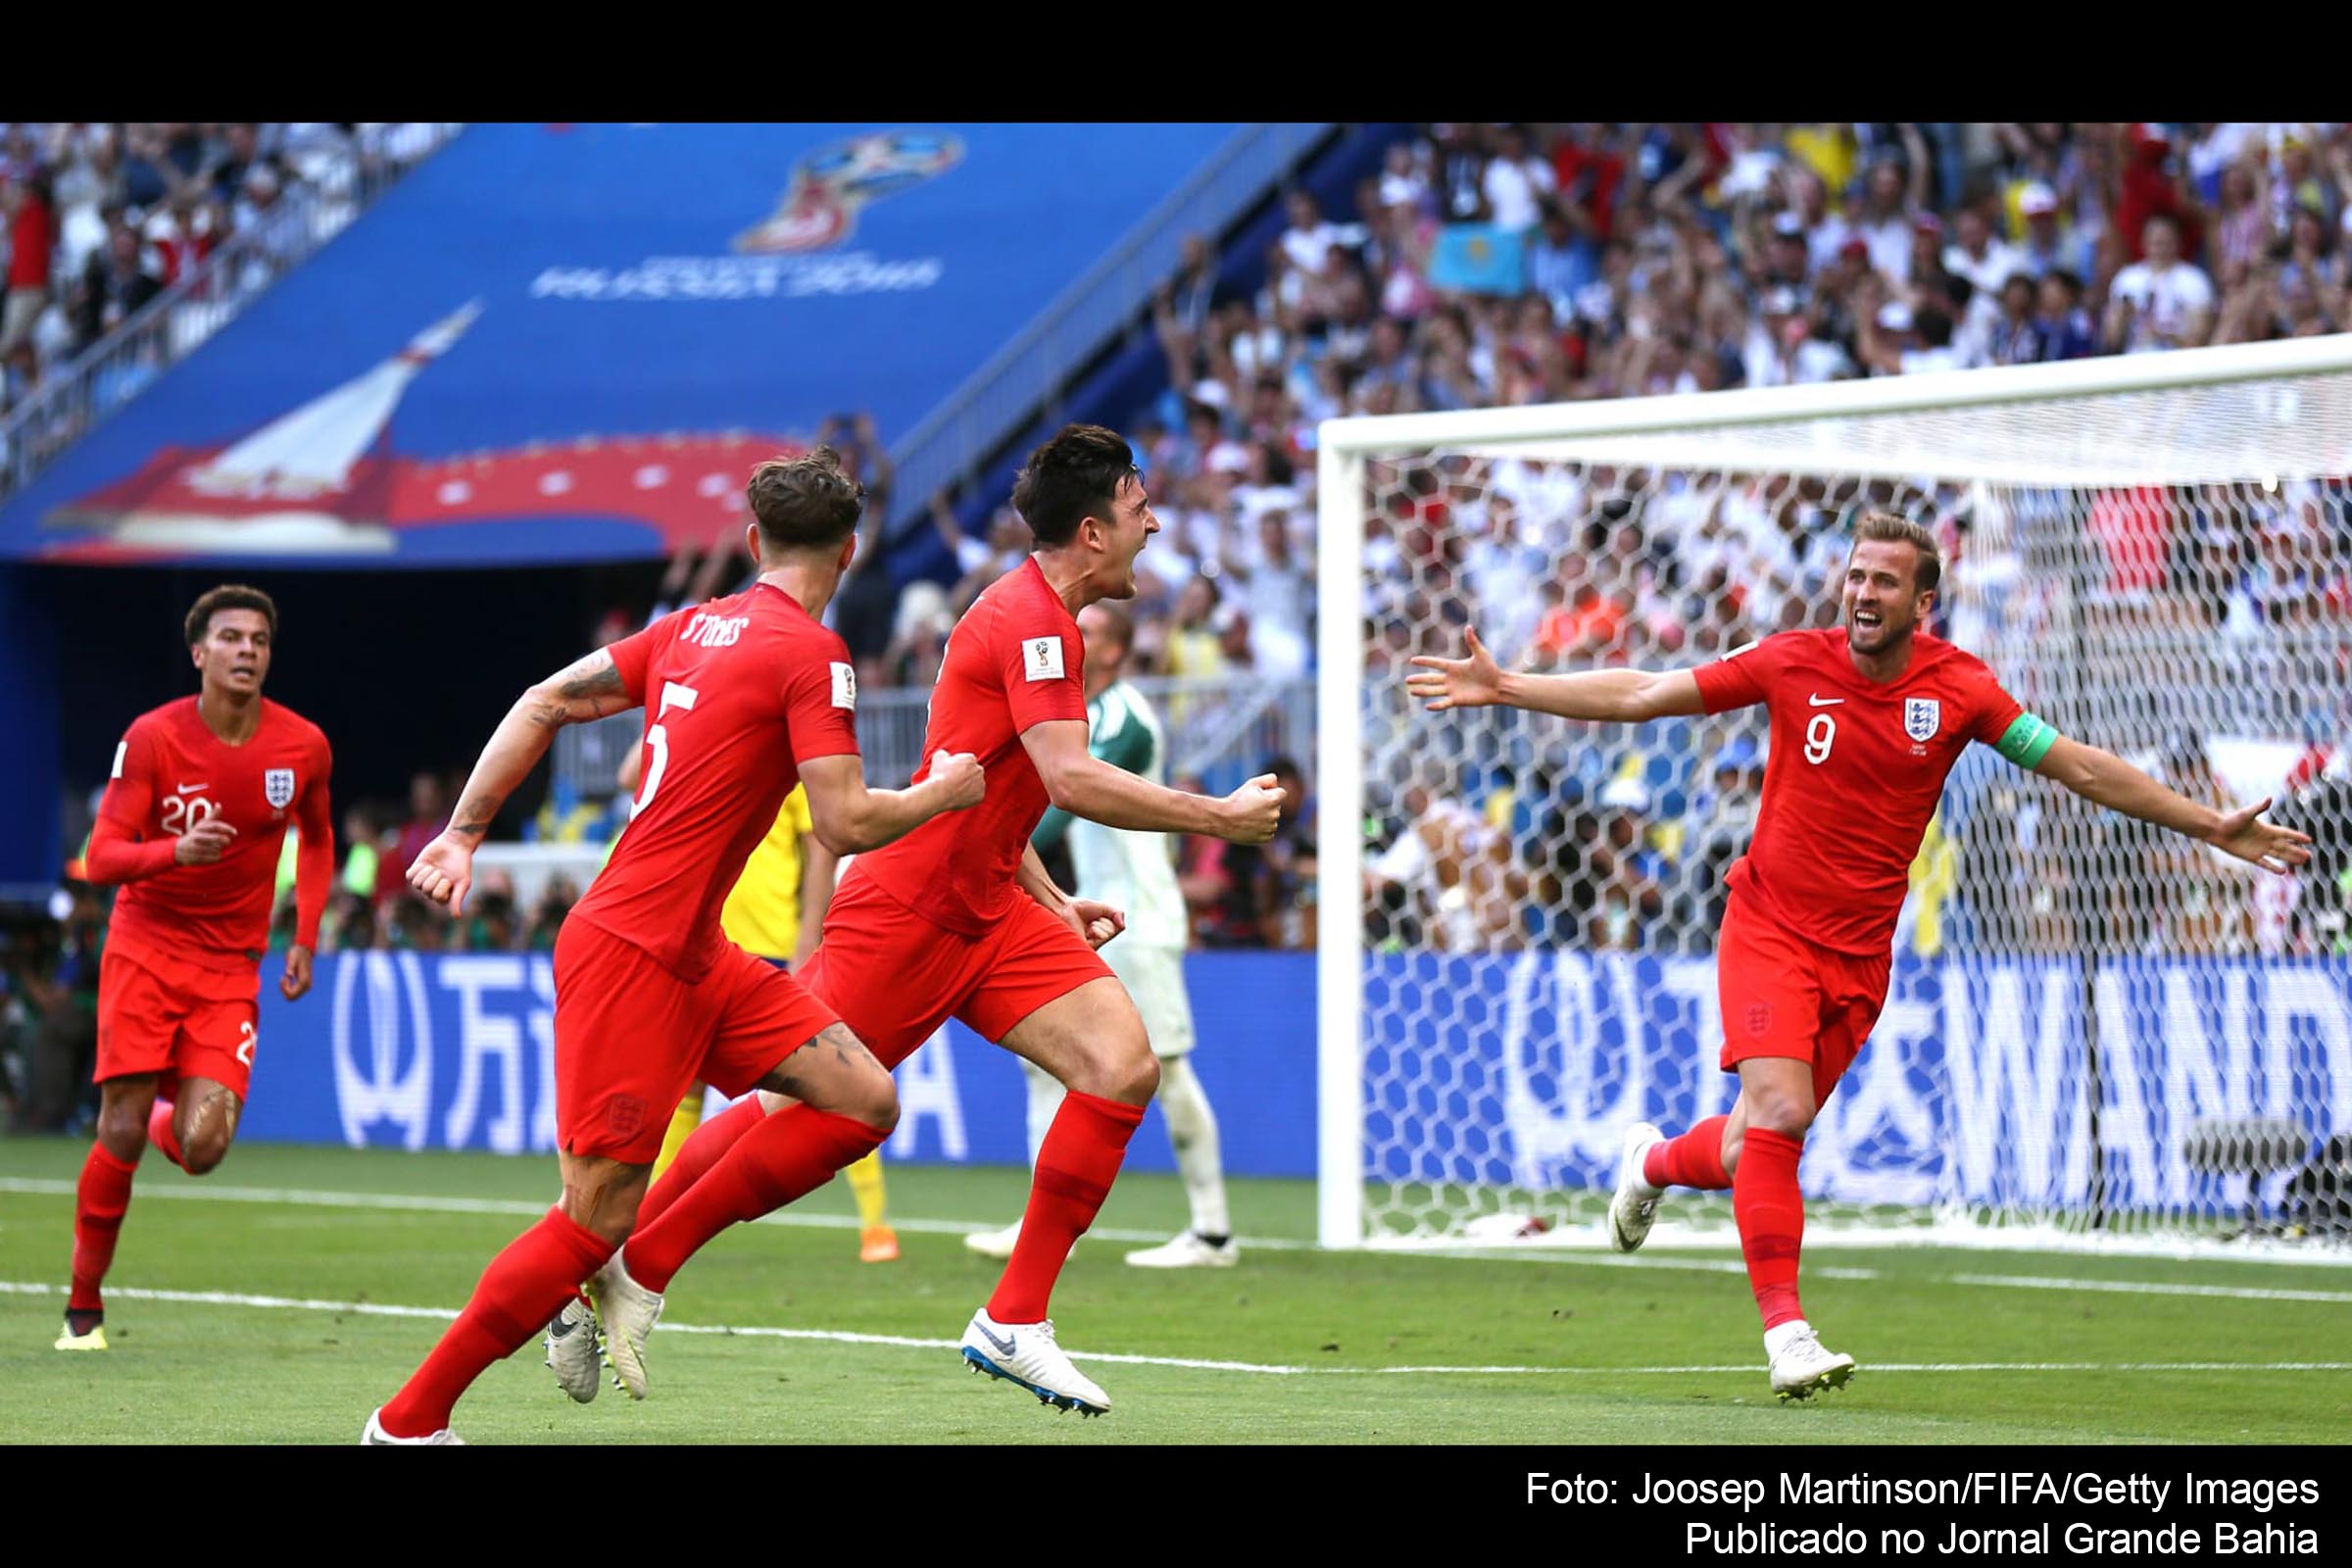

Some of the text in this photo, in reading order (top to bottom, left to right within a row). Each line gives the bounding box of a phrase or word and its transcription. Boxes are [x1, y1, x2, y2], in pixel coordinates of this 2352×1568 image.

[629, 681, 699, 822] 5
[1804, 713, 1836, 765] 9
[171, 795, 213, 836] 20
